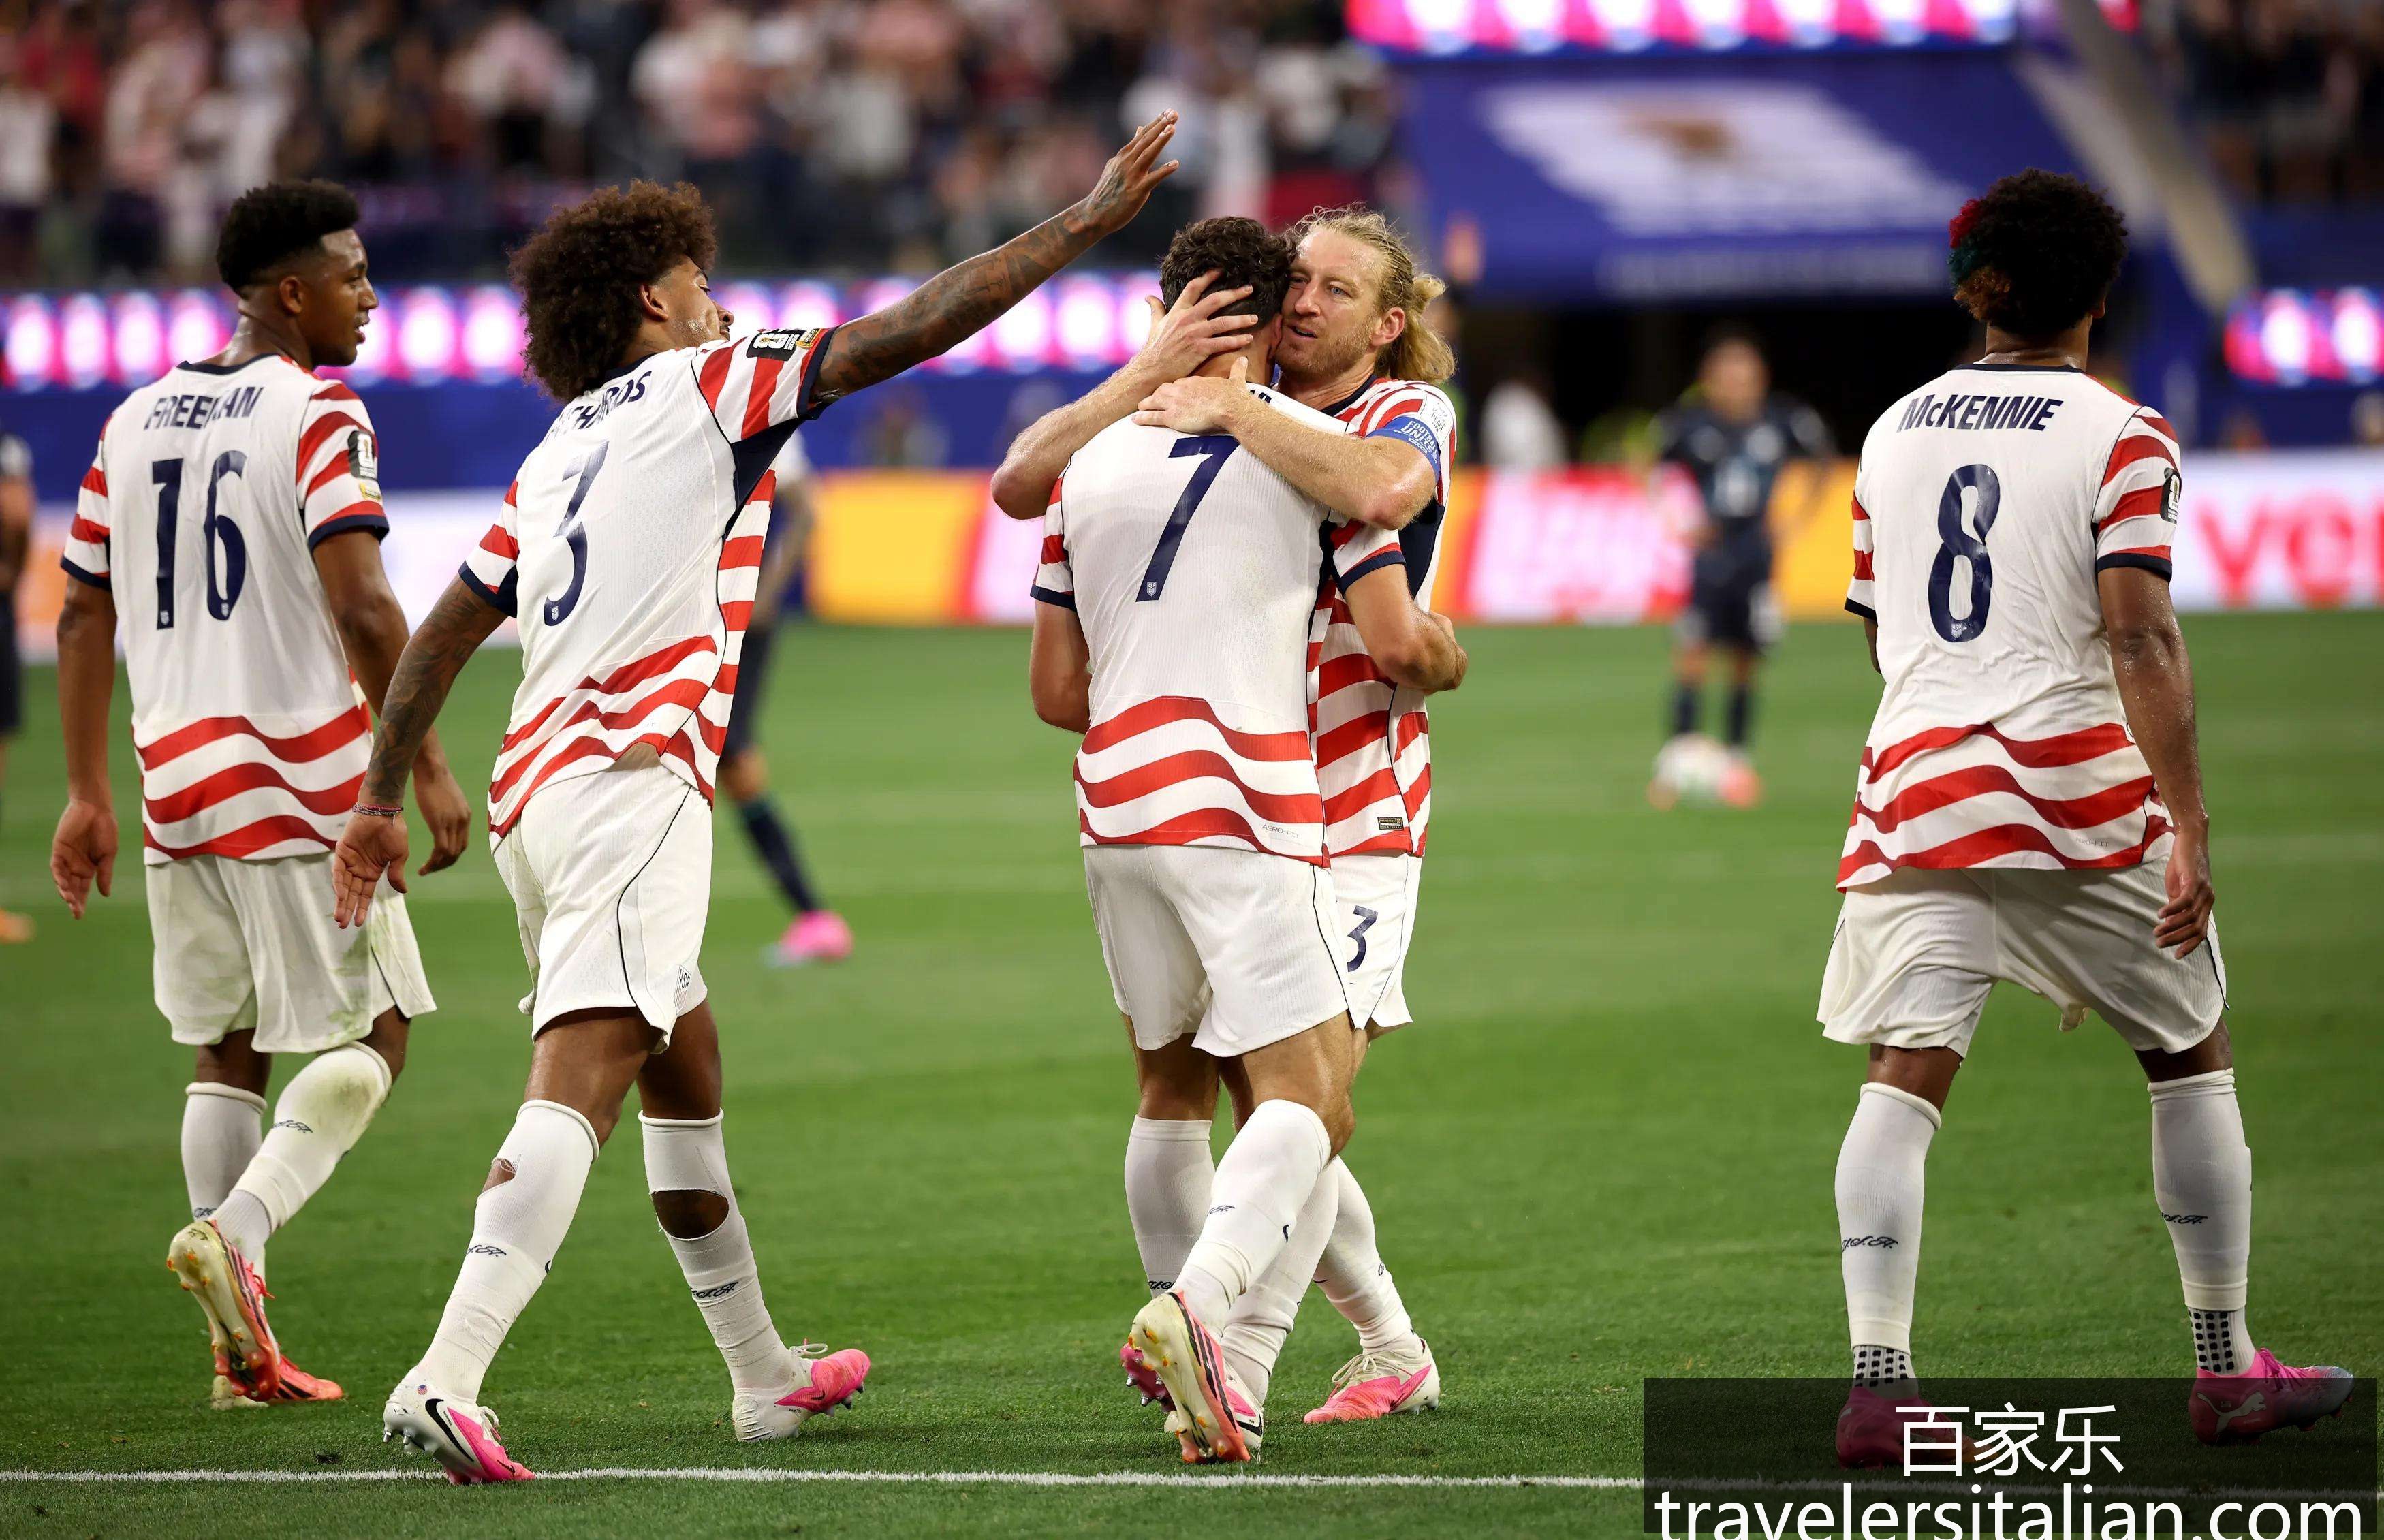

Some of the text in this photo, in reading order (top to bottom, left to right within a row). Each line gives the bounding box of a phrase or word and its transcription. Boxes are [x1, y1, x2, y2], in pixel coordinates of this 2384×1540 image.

[1897, 394, 2065, 433] McKENNIE
[151, 450, 249, 631] 16
[544, 441, 610, 626] 3
[1135, 434, 1240, 603] 7
[1928, 464, 2001, 643] 8
[1347, 905, 1379, 972] 3
